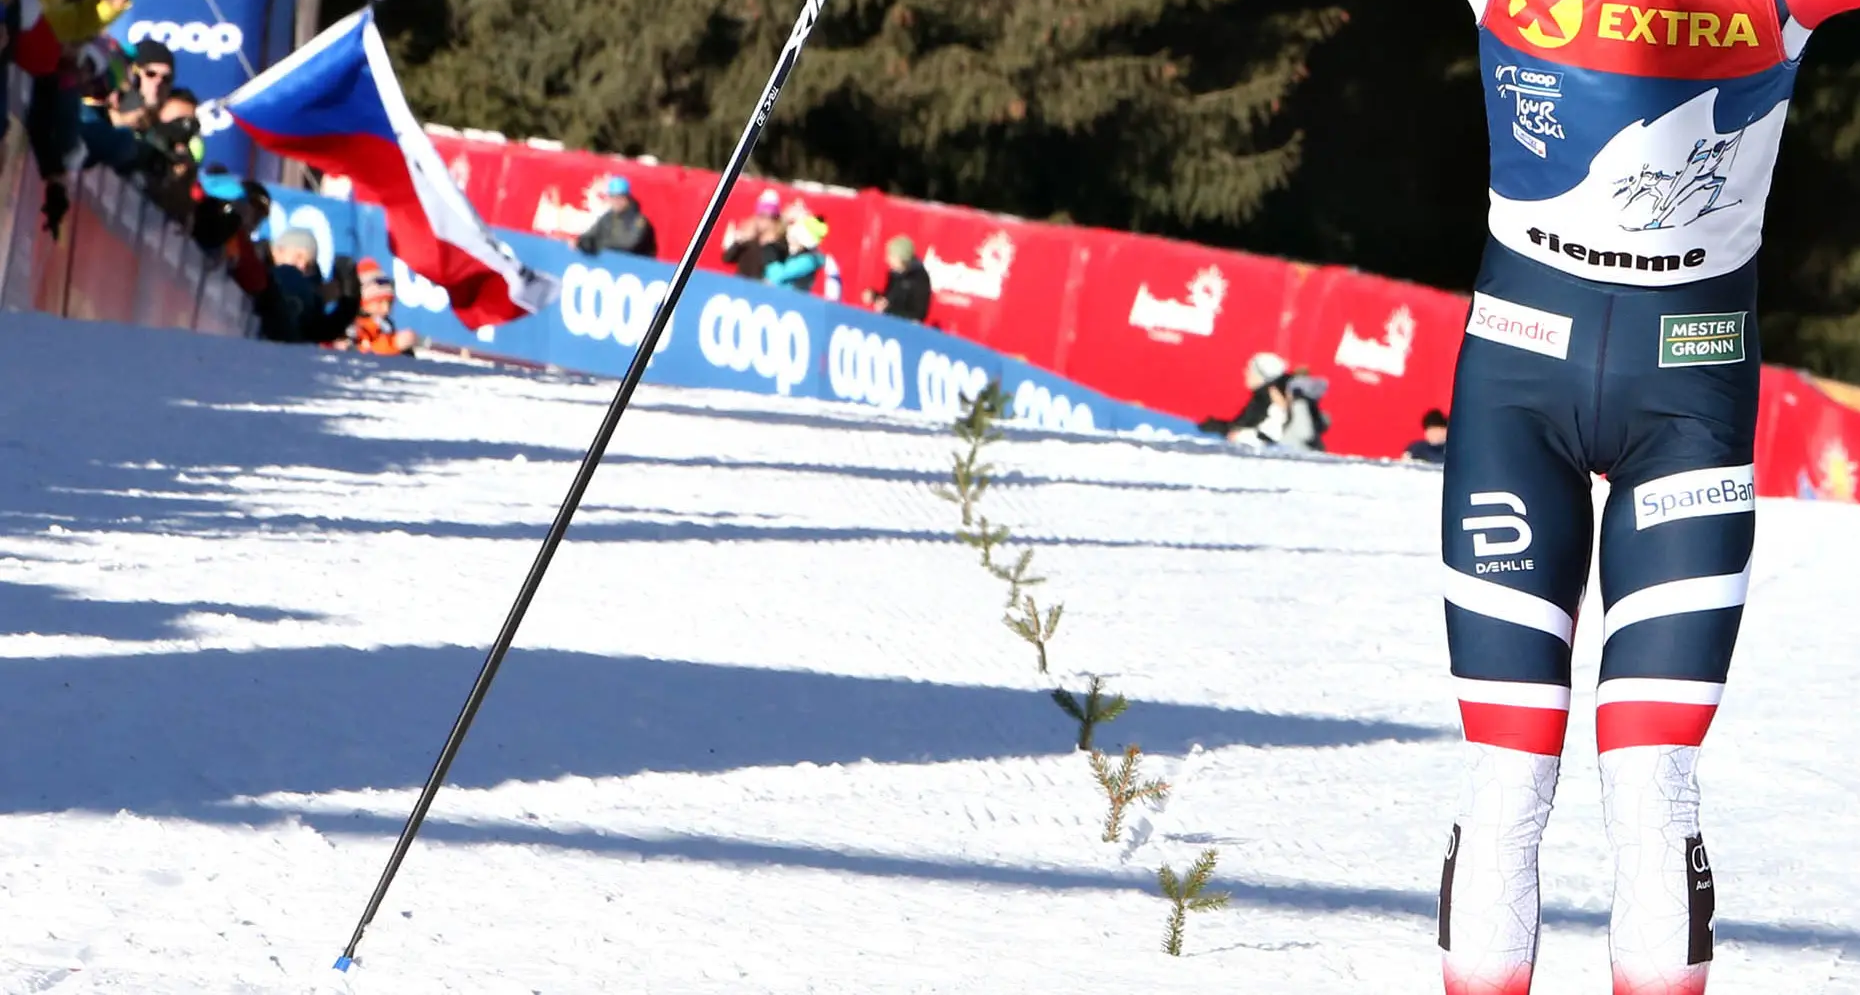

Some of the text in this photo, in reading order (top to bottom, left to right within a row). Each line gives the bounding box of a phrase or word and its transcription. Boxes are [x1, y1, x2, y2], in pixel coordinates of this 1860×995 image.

[1598, 3, 1760, 47] EXTRA
[1521, 72, 1556, 87] coop
[1526, 227, 1706, 271] fiemme
[1476, 307, 1560, 344] Scandic
[1671, 320, 1736, 337] MESTER
[699, 293, 810, 396] coop
[1671, 340, 1734, 357] GRØNN
[1642, 479, 1754, 517] SpareBan
[1475, 559, 1535, 574] DÆHLIE
